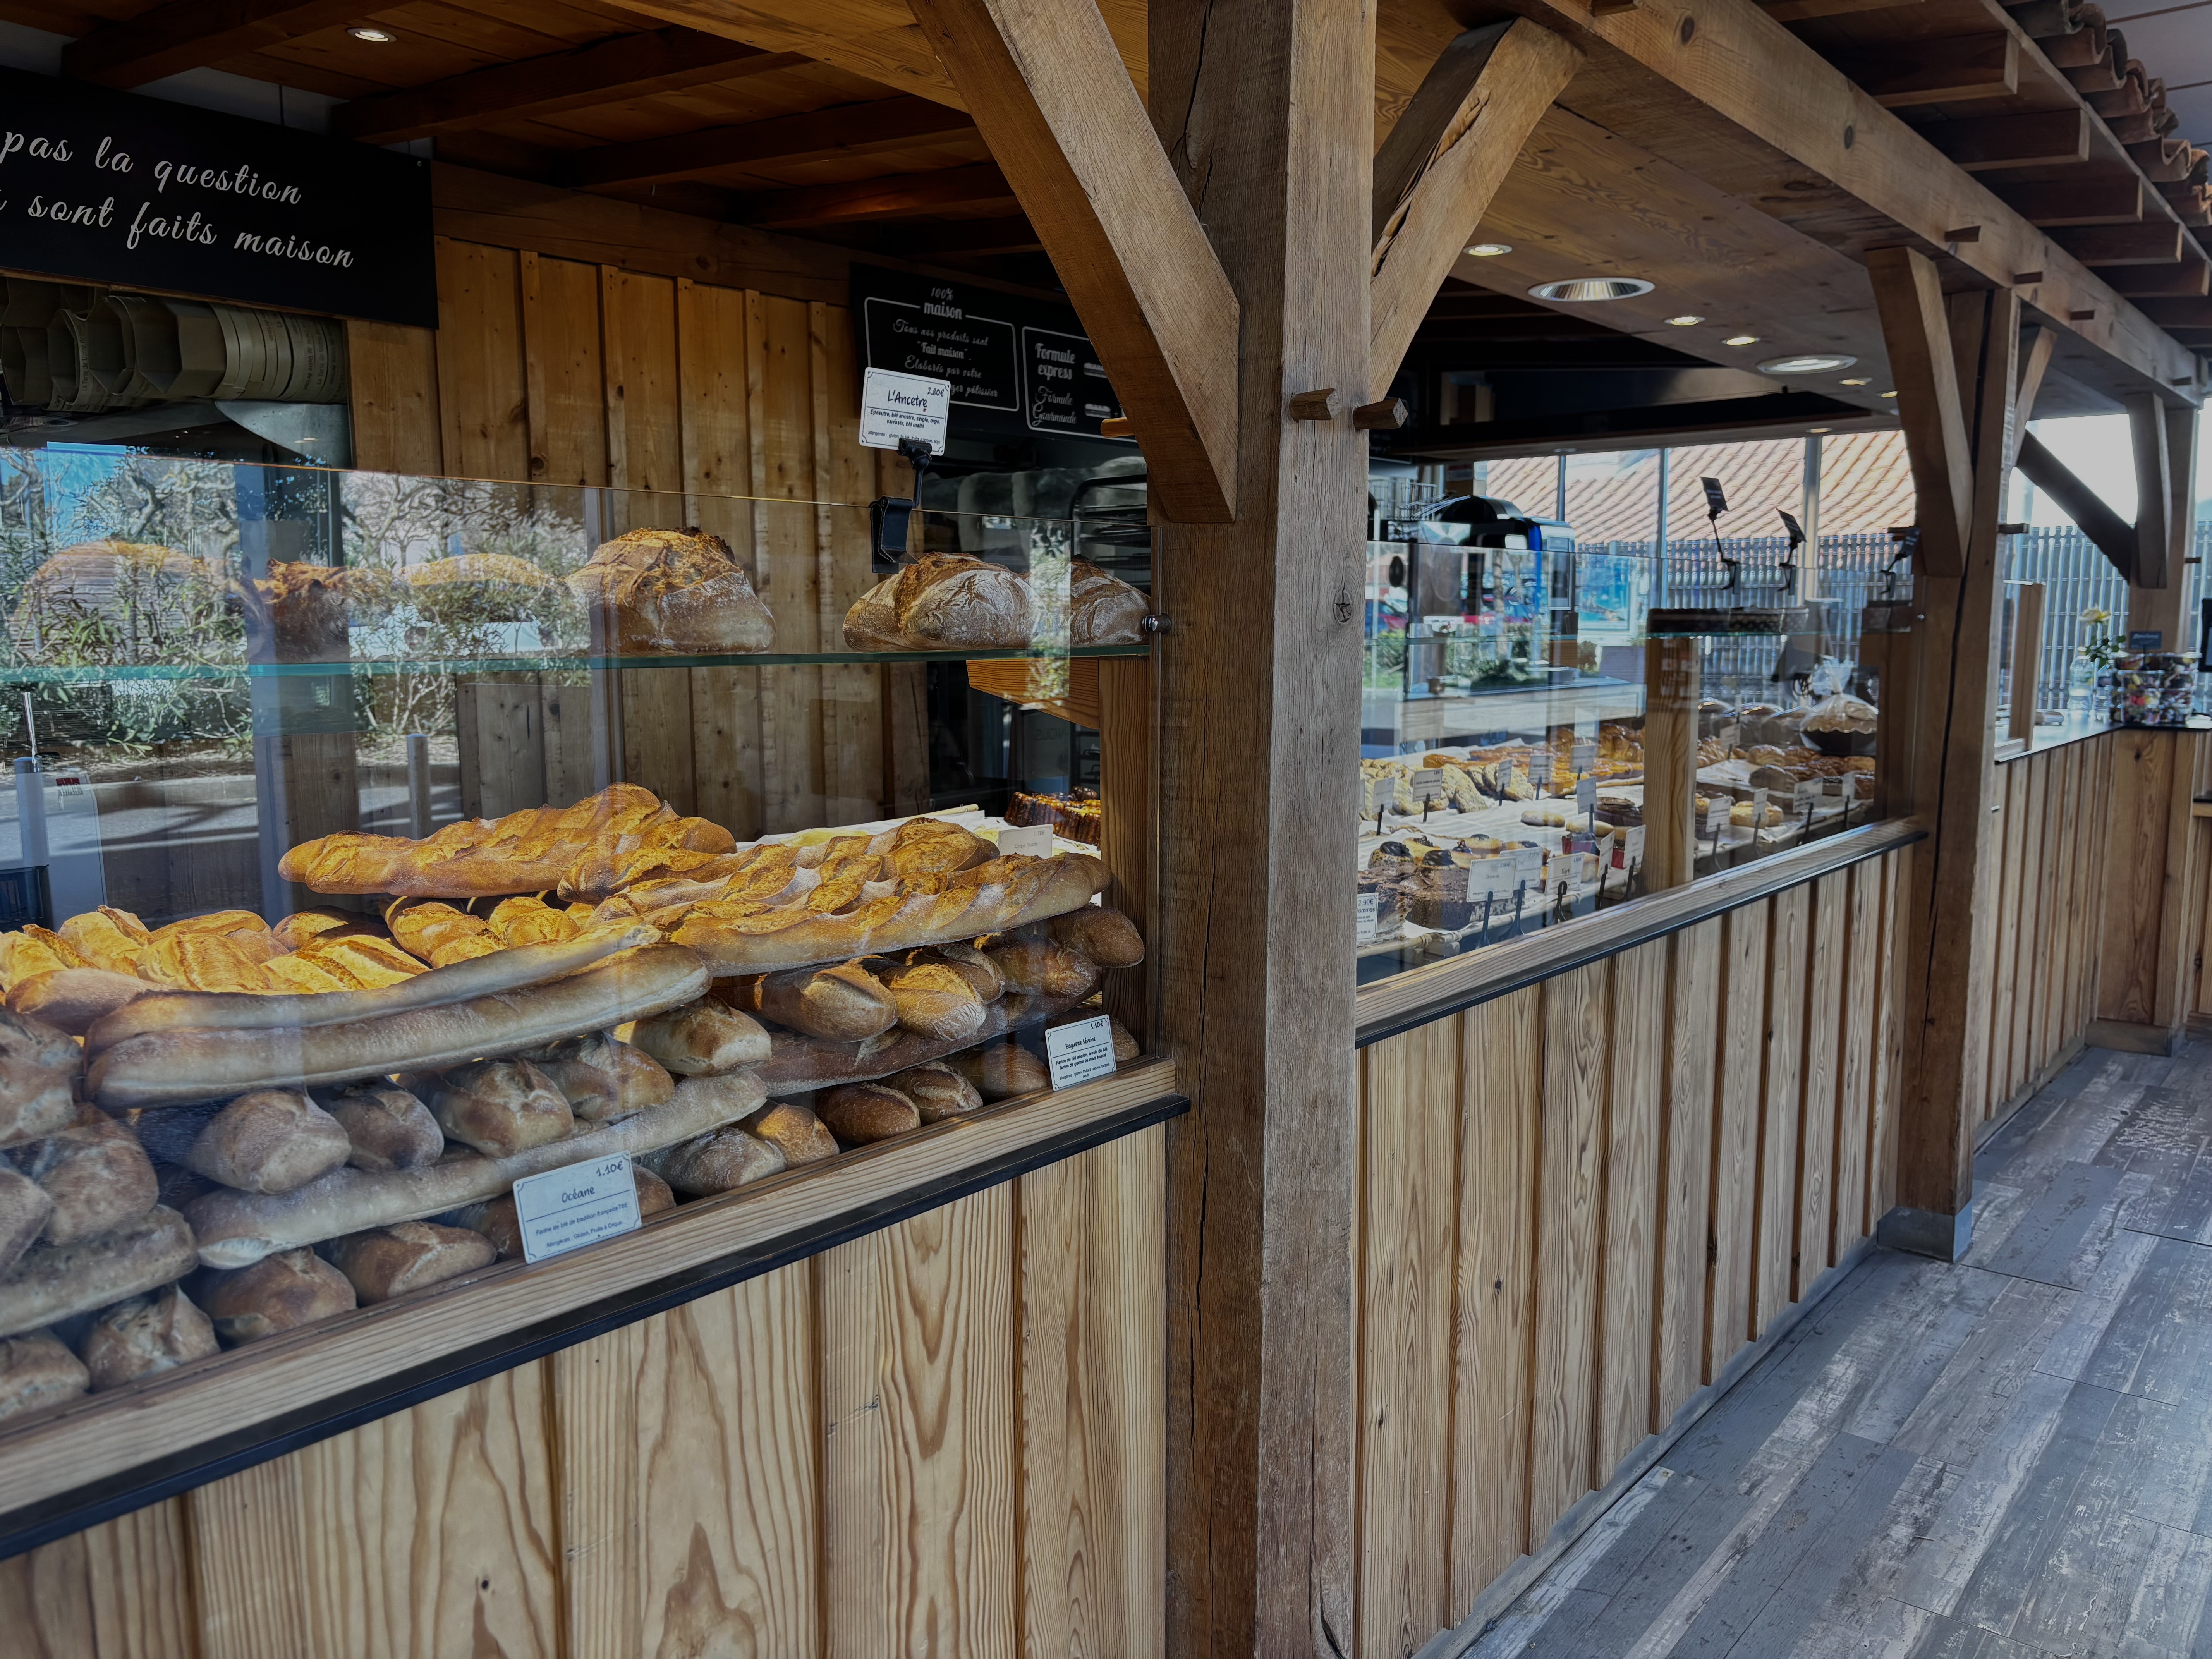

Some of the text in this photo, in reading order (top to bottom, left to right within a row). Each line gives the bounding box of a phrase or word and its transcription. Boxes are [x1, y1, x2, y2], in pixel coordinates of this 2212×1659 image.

[0, 132, 302, 205] pas la question
[28, 195, 115, 228] sont
[126, 202, 218, 250] faits
[233, 231, 354, 268] maison
[931, 287, 953, 301] 100%
[923, 301, 963, 320] maison
[892, 319, 918, 334] Tous
[1035, 343, 1076, 364] Formule
[1038, 364, 1073, 381] express
[927, 387, 944, 397] 2.80€
[1090, 1020, 1103, 1030] 1.10€
[1065, 1042, 1083, 1050] Baguette
[596, 1160, 623, 1177] 1.10€
[562, 1186, 595, 1203] Océane
[536, 1226, 552, 1236] Farine
[576, 1212, 596, 1223] tradition
